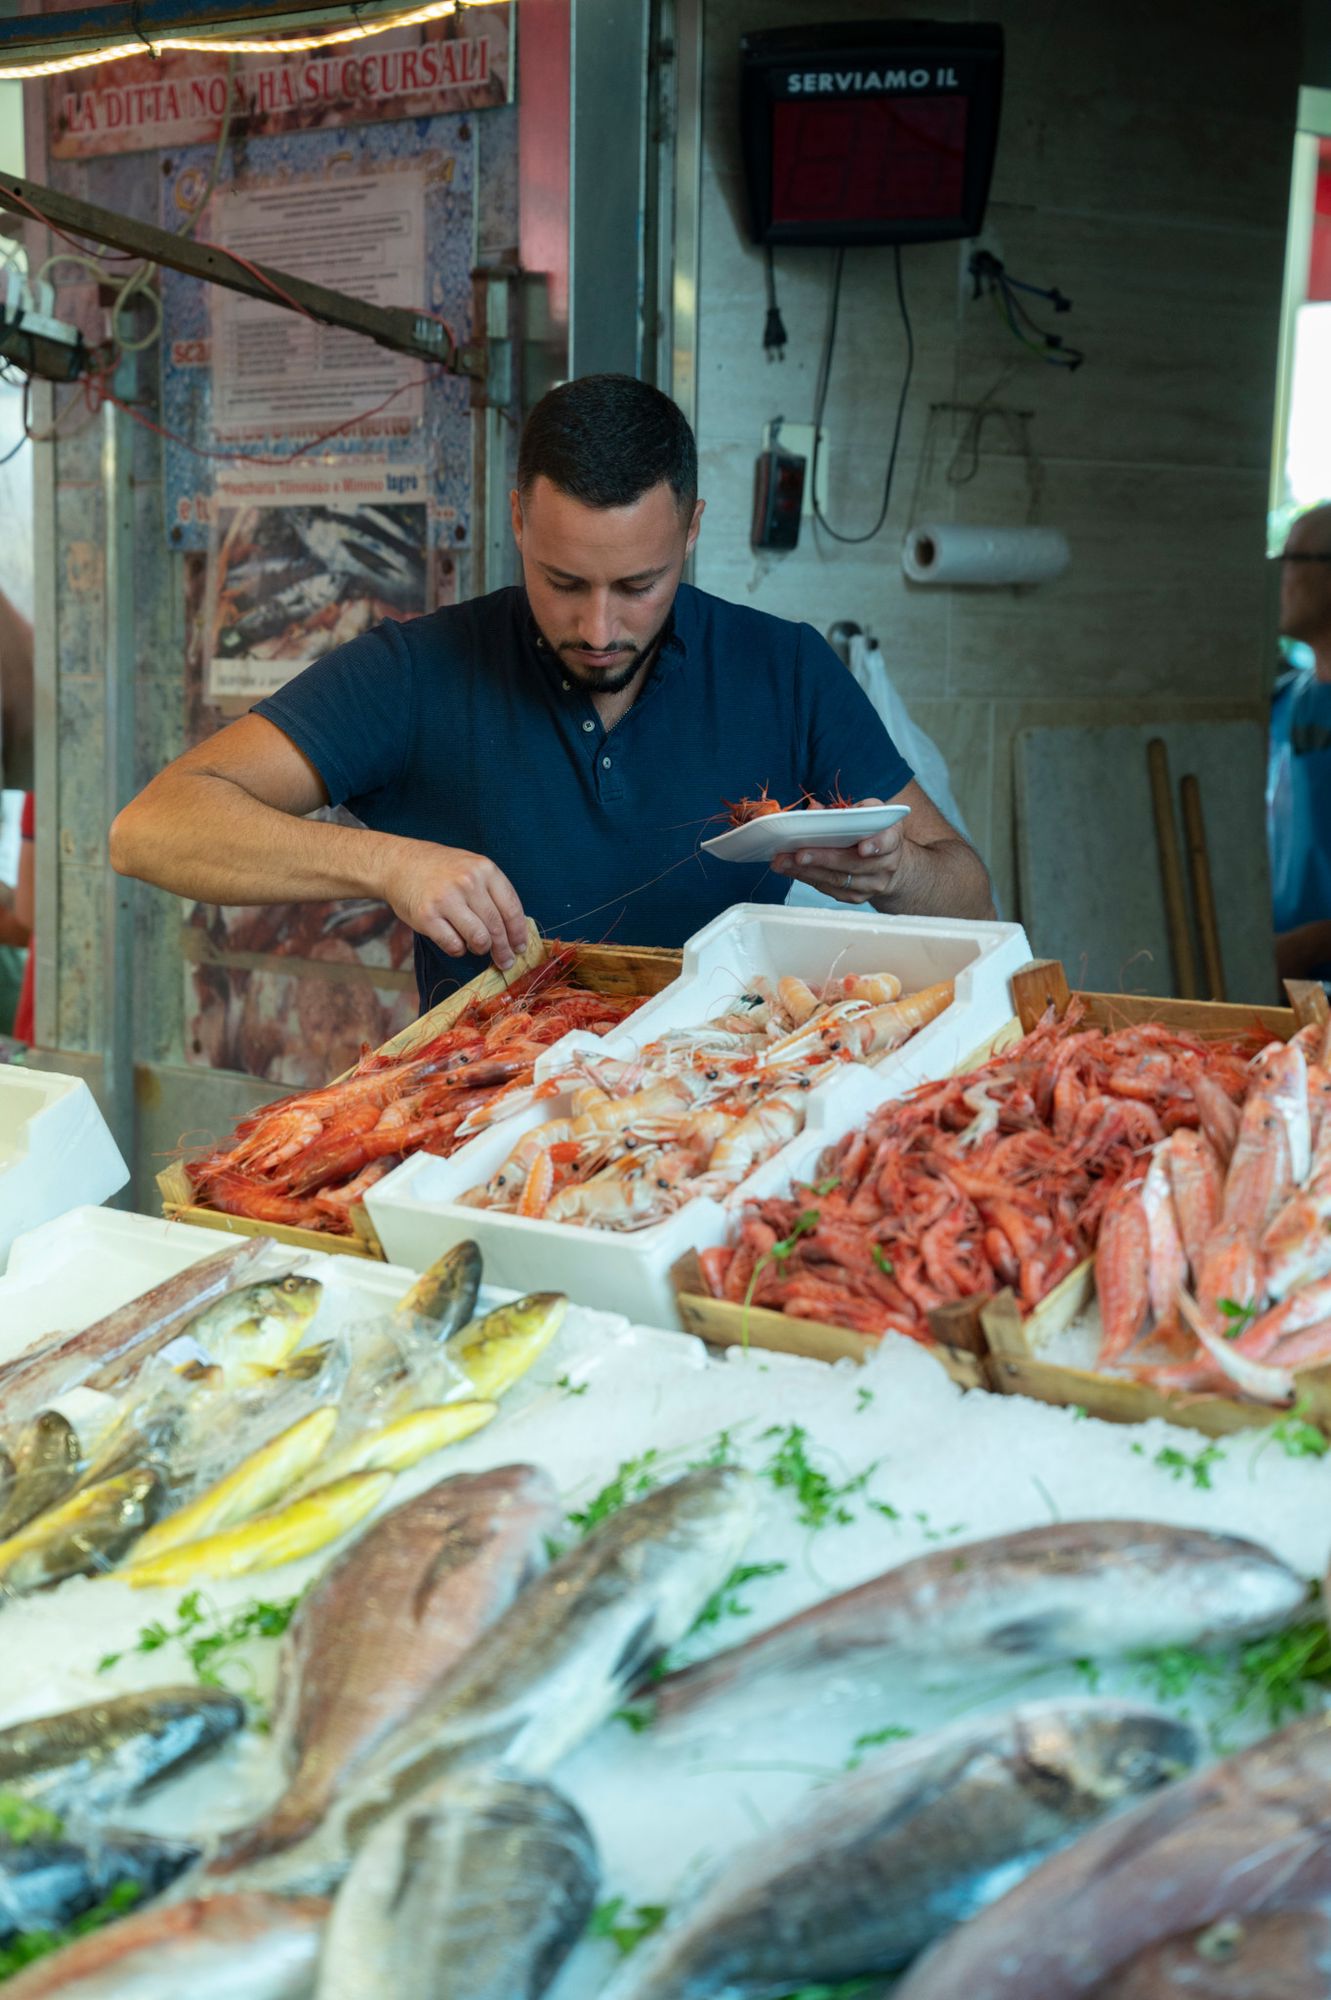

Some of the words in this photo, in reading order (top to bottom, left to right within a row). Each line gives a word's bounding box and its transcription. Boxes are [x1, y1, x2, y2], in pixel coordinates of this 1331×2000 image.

[67, 94, 97, 133] LA
[106, 84, 181, 129] DITTA
[190, 75, 248, 119] NON
[258, 67, 295, 108] HA
[304, 39, 489, 100] SUCCURSALI
[788, 69, 930, 93] SERVIAMO
[936, 68, 958, 87] IL
